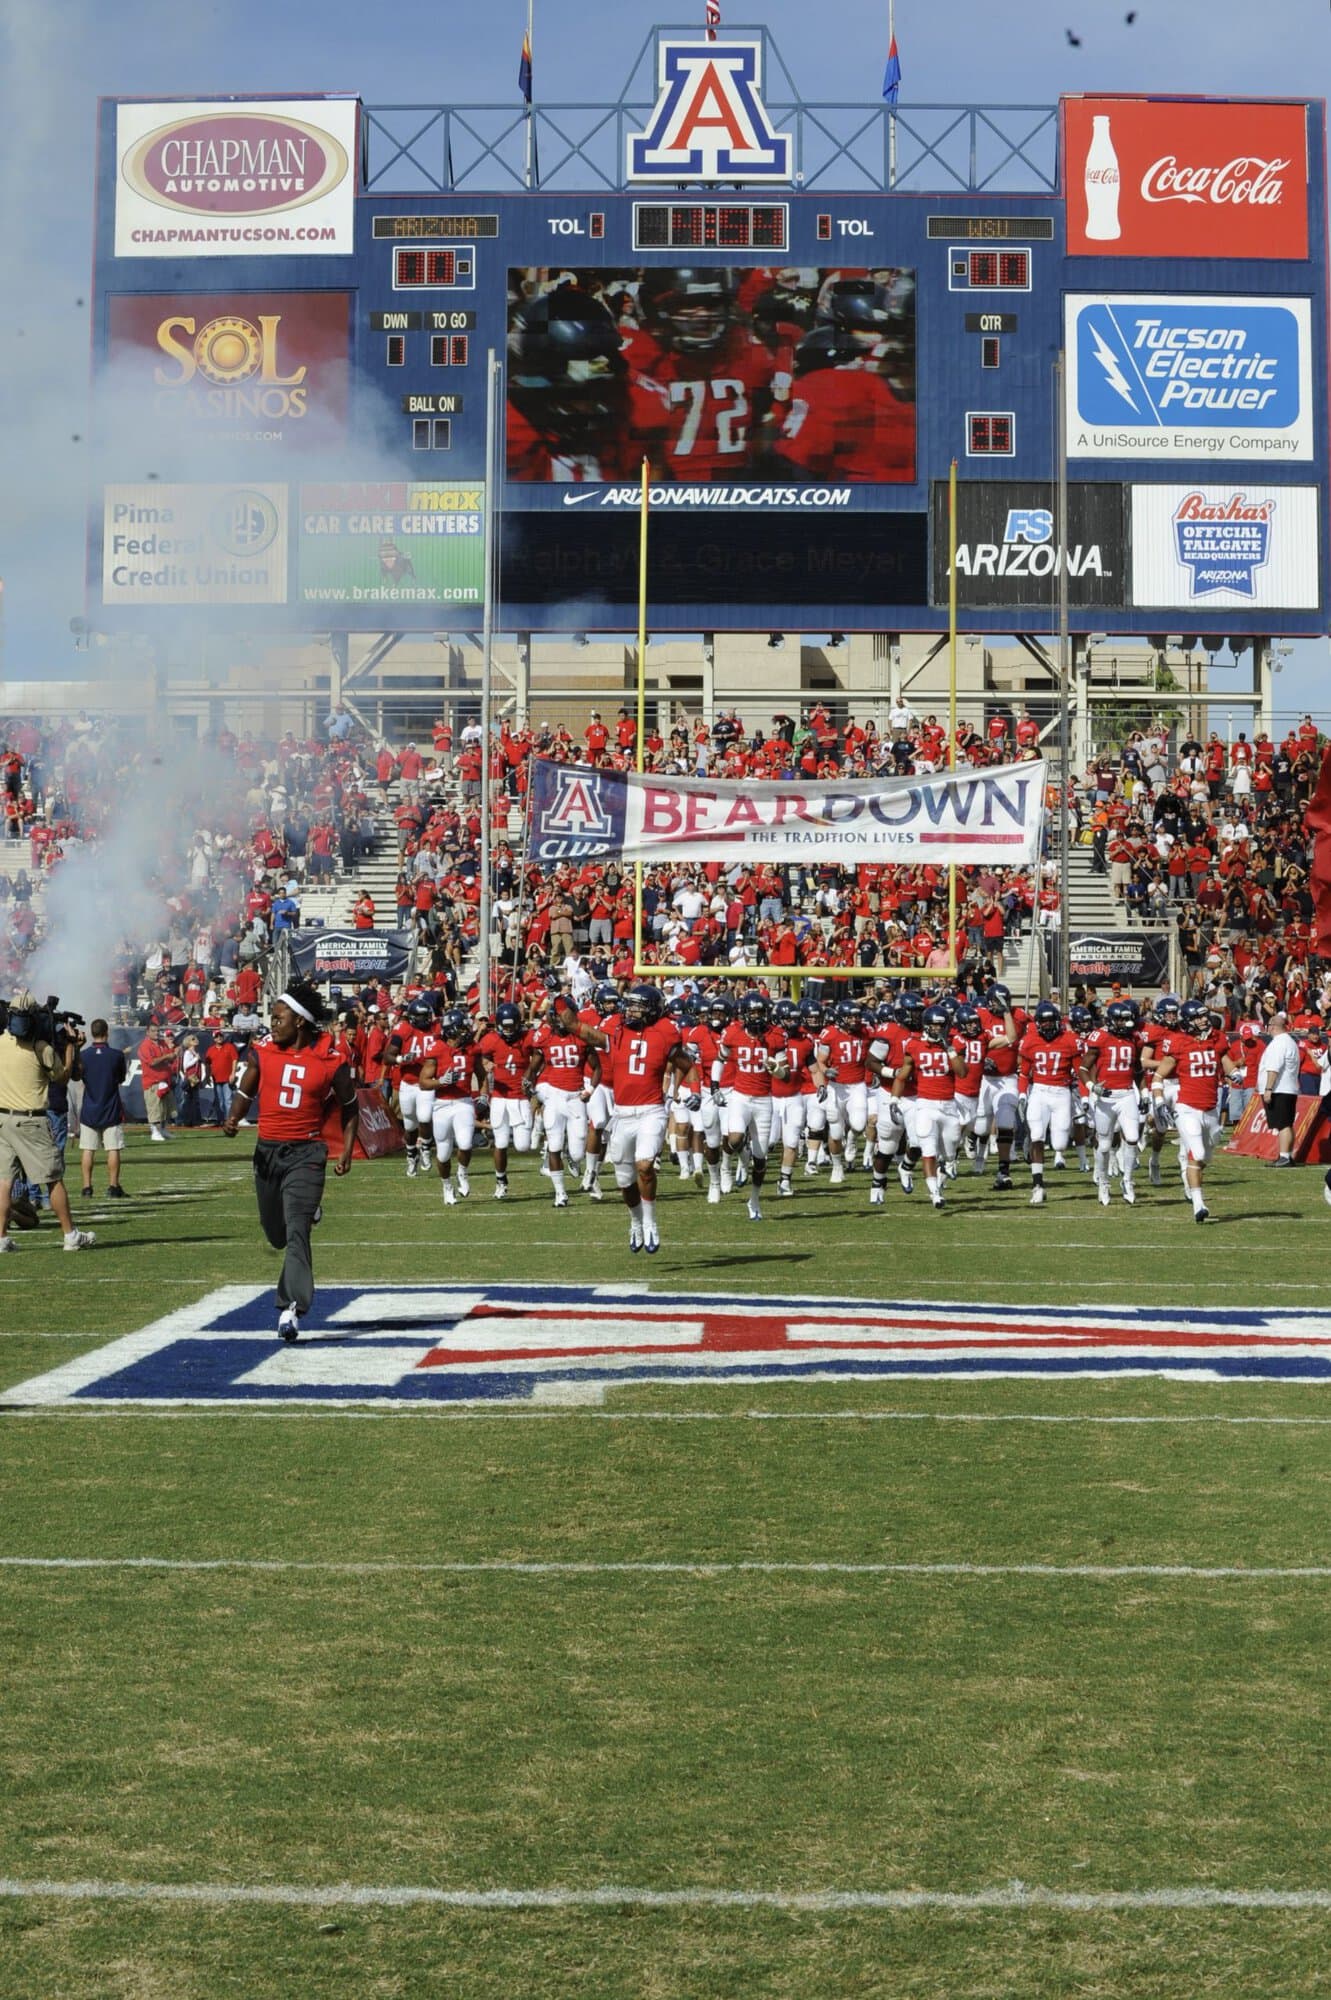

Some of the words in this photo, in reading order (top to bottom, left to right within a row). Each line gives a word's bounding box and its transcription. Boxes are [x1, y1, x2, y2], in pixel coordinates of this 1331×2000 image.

[161, 139, 308, 177] CHAPMAN
[164, 178, 305, 193] AUTOMOTIVE
[1141, 155, 1291, 205] Coca-Cola
[131, 227, 336, 243] CHAPMANTUCSON.COM
[394, 217, 478, 238] ARIZONA
[548, 219, 584, 235] TOL
[837, 220, 874, 236] TOL
[968, 219, 1009, 237] WSU
[383, 313, 408, 329] DWN
[432, 313, 447, 329] TO
[450, 313, 467, 328] GO
[980, 314, 1002, 331] QTR
[1133, 319, 1248, 350] Tucson
[154, 315, 307, 387] SOL
[1145, 349, 1278, 380] Electric
[409, 397, 435, 411] BALL
[439, 396, 455, 411] ON
[1159, 380, 1278, 410] Power
[670, 379, 747, 456] 72
[1077, 434, 1088, 446] A
[1093, 434, 1169, 447] UniSource
[1174, 434, 1225, 451] Energy
[1229, 435, 1299, 452] Company
[410, 490, 484, 512] max
[112, 503, 174, 524] Pima
[304, 514, 341, 534] CAR
[347, 514, 394, 534] CARE
[401, 513, 480, 533] CENTERS
[1003, 509, 1054, 544] FS
[1183, 526, 1262, 538] OFFICIAL
[1183, 539, 1262, 551] TAILGATE
[1184, 552, 1261, 561] HEADQUARTERS
[946, 543, 1104, 577] ARIZONA
[112, 566, 188, 587] Credit
[195, 564, 269, 586] Union
[304, 585, 479, 600] www.brakemax.com
[752, 831, 779, 842] THE
[784, 831, 867, 843] TRADITION
[873, 831, 915, 843] LIVES
[360, 941, 388, 949] FAMILY
[550, 1044, 579, 1068] 26
[628, 1039, 649, 1075] 2
[738, 1046, 768, 1073] 23
[839, 1040, 863, 1064] 37
[1035, 1051, 1062, 1075] 27
[1106, 1045, 1133, 1072] 19
[453, 1055, 466, 1081] 2
[505, 1053, 517, 1076] 4
[920, 1052, 949, 1077] 23
[1188, 1050, 1218, 1078] 25
[279, 1063, 306, 1109] 5
